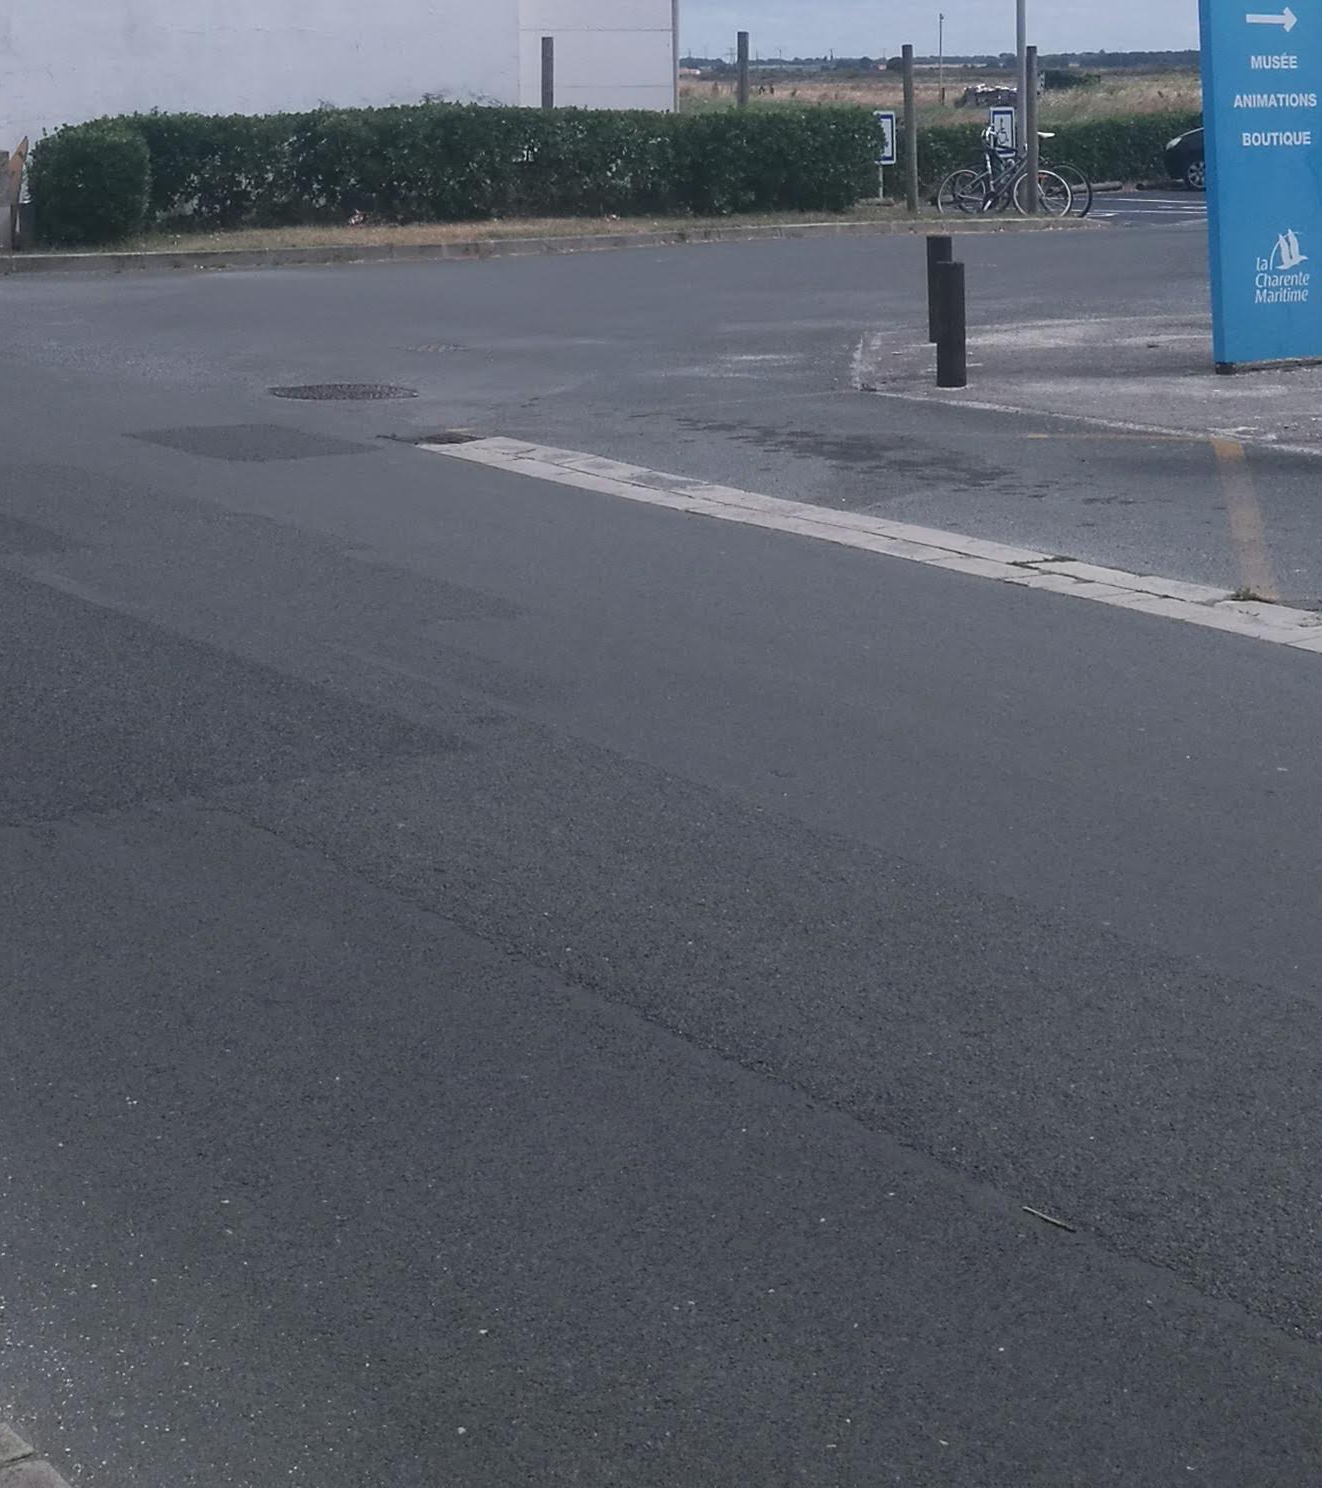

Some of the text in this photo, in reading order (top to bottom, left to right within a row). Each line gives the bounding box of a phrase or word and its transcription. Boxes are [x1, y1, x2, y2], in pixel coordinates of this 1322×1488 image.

[1250, 53, 1298, 70] MUSÉE
[1234, 93, 1318, 108] ANIMATIONS
[1242, 132, 1312, 146] BOUTIQUE
[1256, 257, 1268, 271] la
[1255, 272, 1310, 287] Charente
[1255, 288, 1309, 304] Maritime
